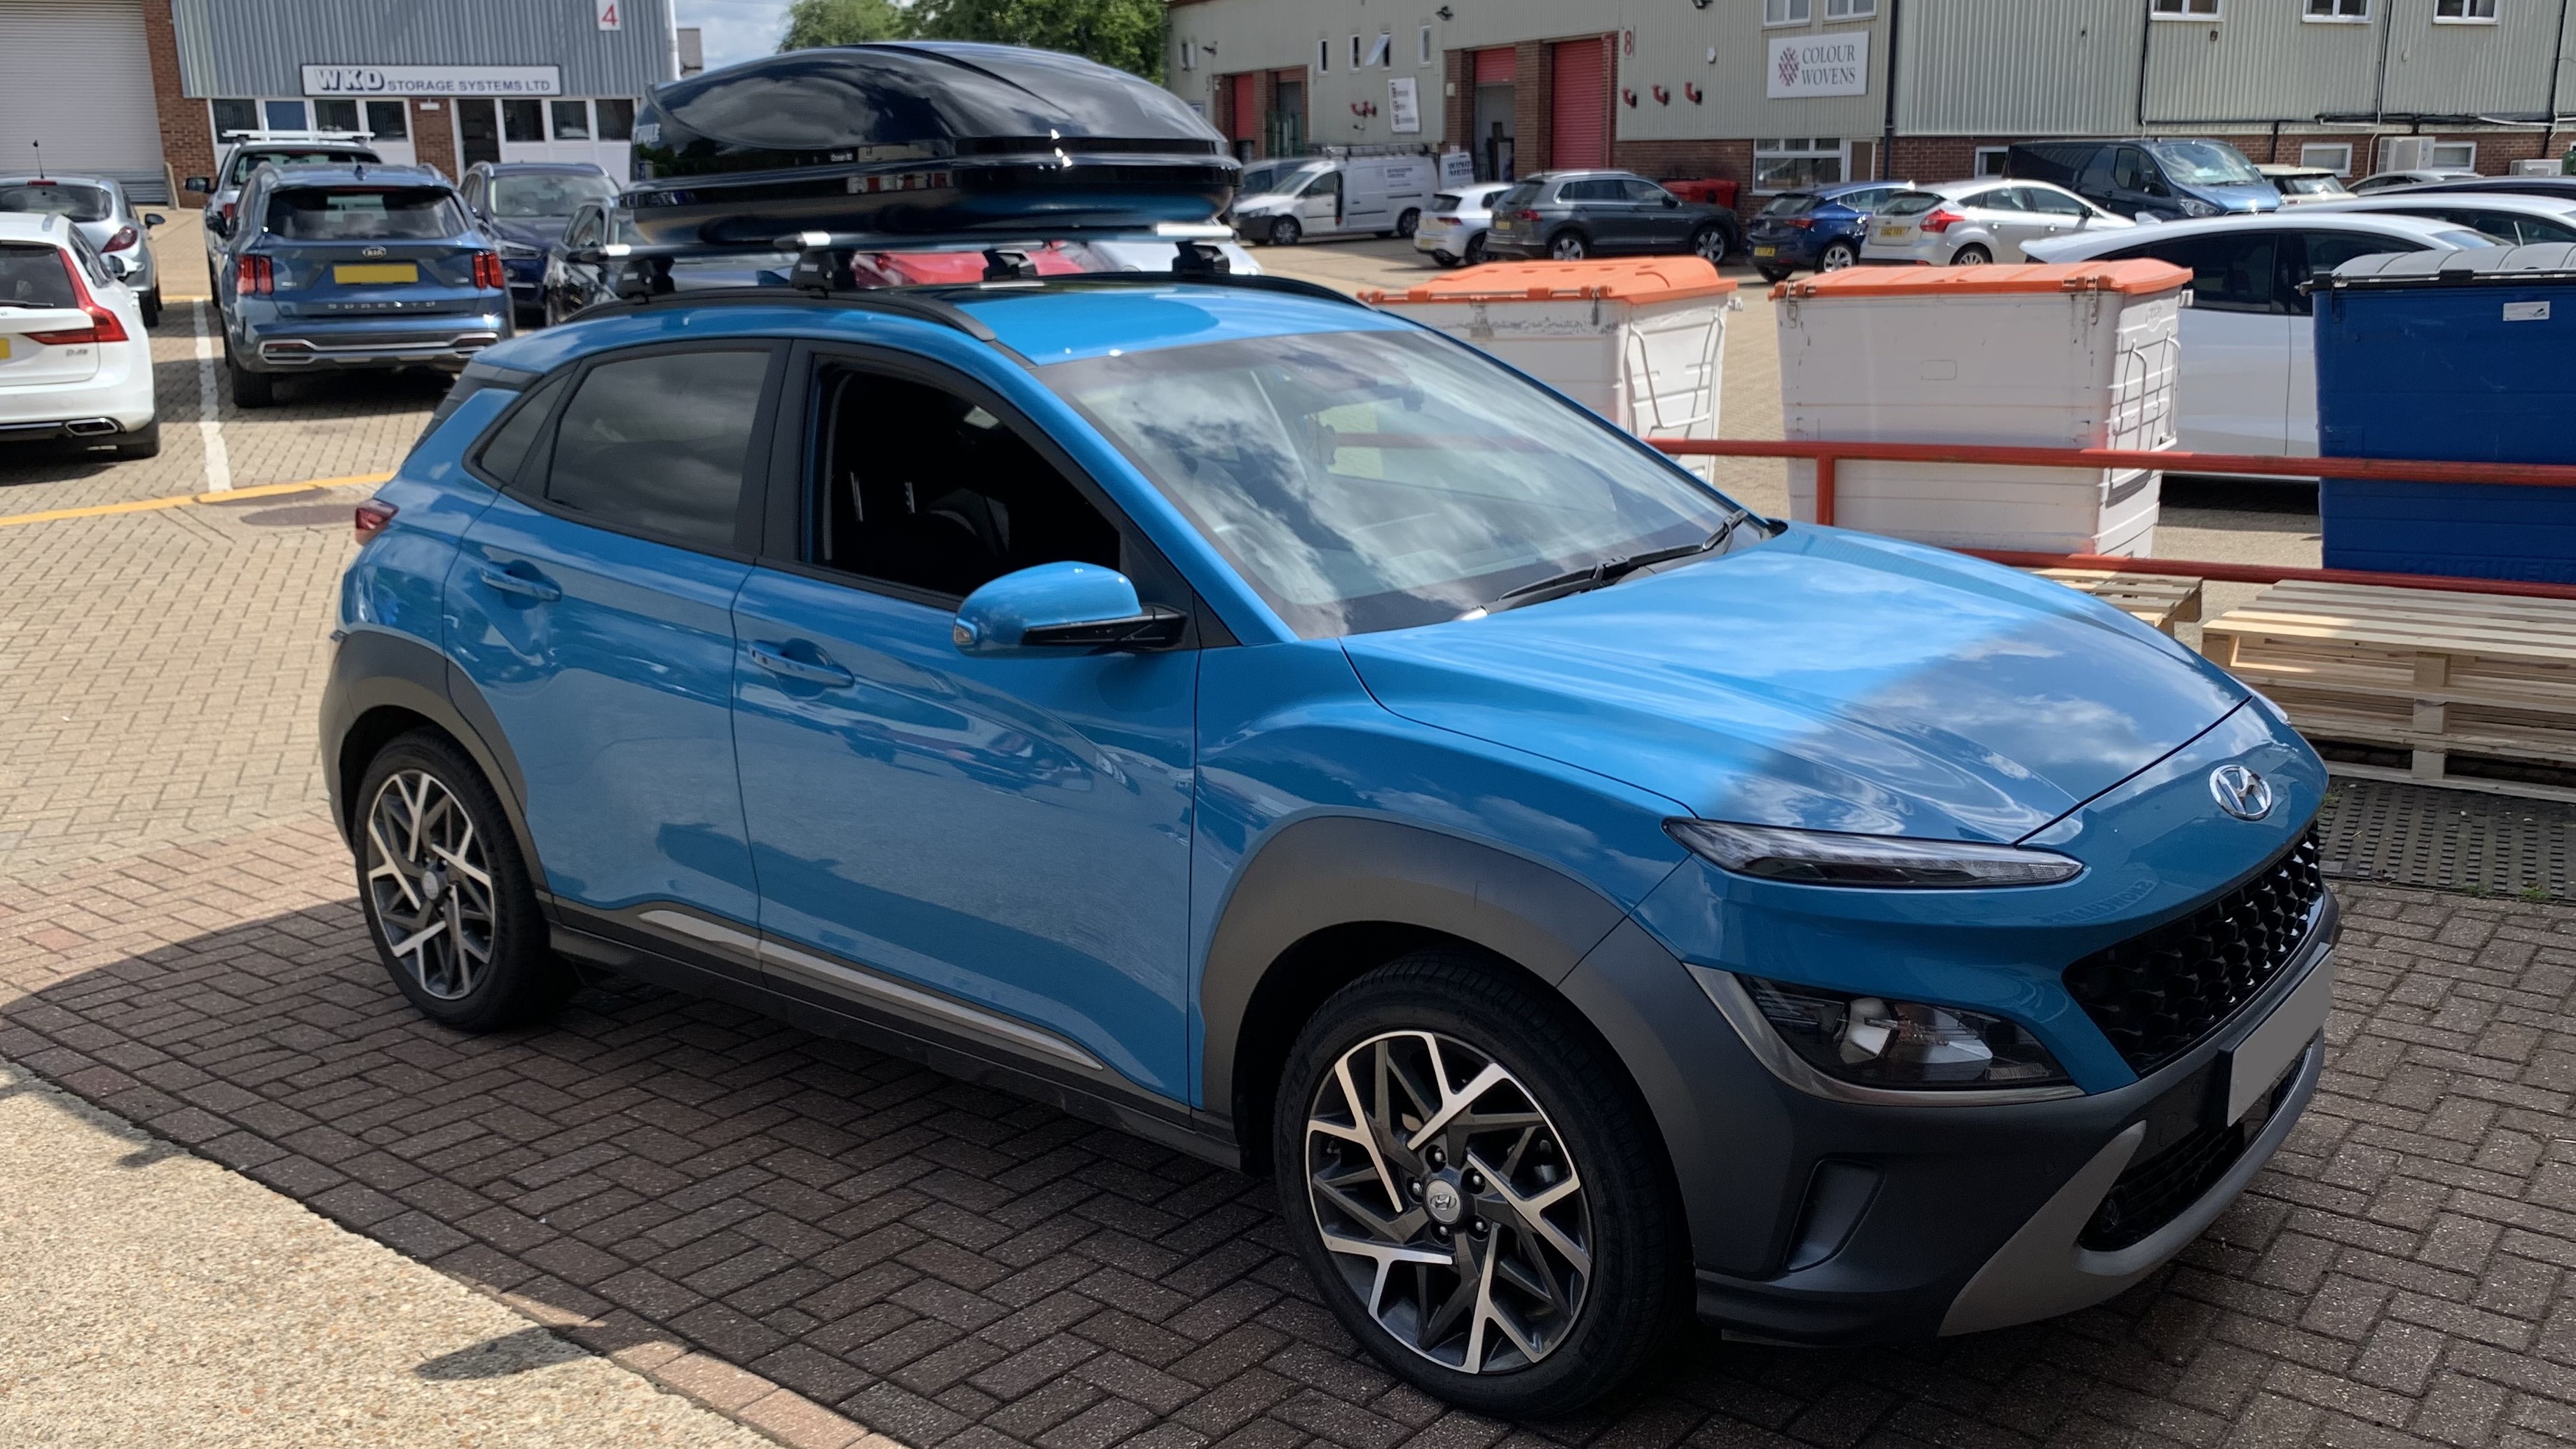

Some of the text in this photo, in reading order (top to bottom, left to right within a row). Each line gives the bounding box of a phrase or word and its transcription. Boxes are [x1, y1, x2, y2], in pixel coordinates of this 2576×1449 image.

[602, 4, 618, 26] 4
[1624, 30, 1632, 56] 8
[1802, 44, 1855, 64] COLOUR
[317, 69, 550, 92] WKD STORAGE SYSTEMS LTD
[1802, 67, 1856, 85] WOVENS
